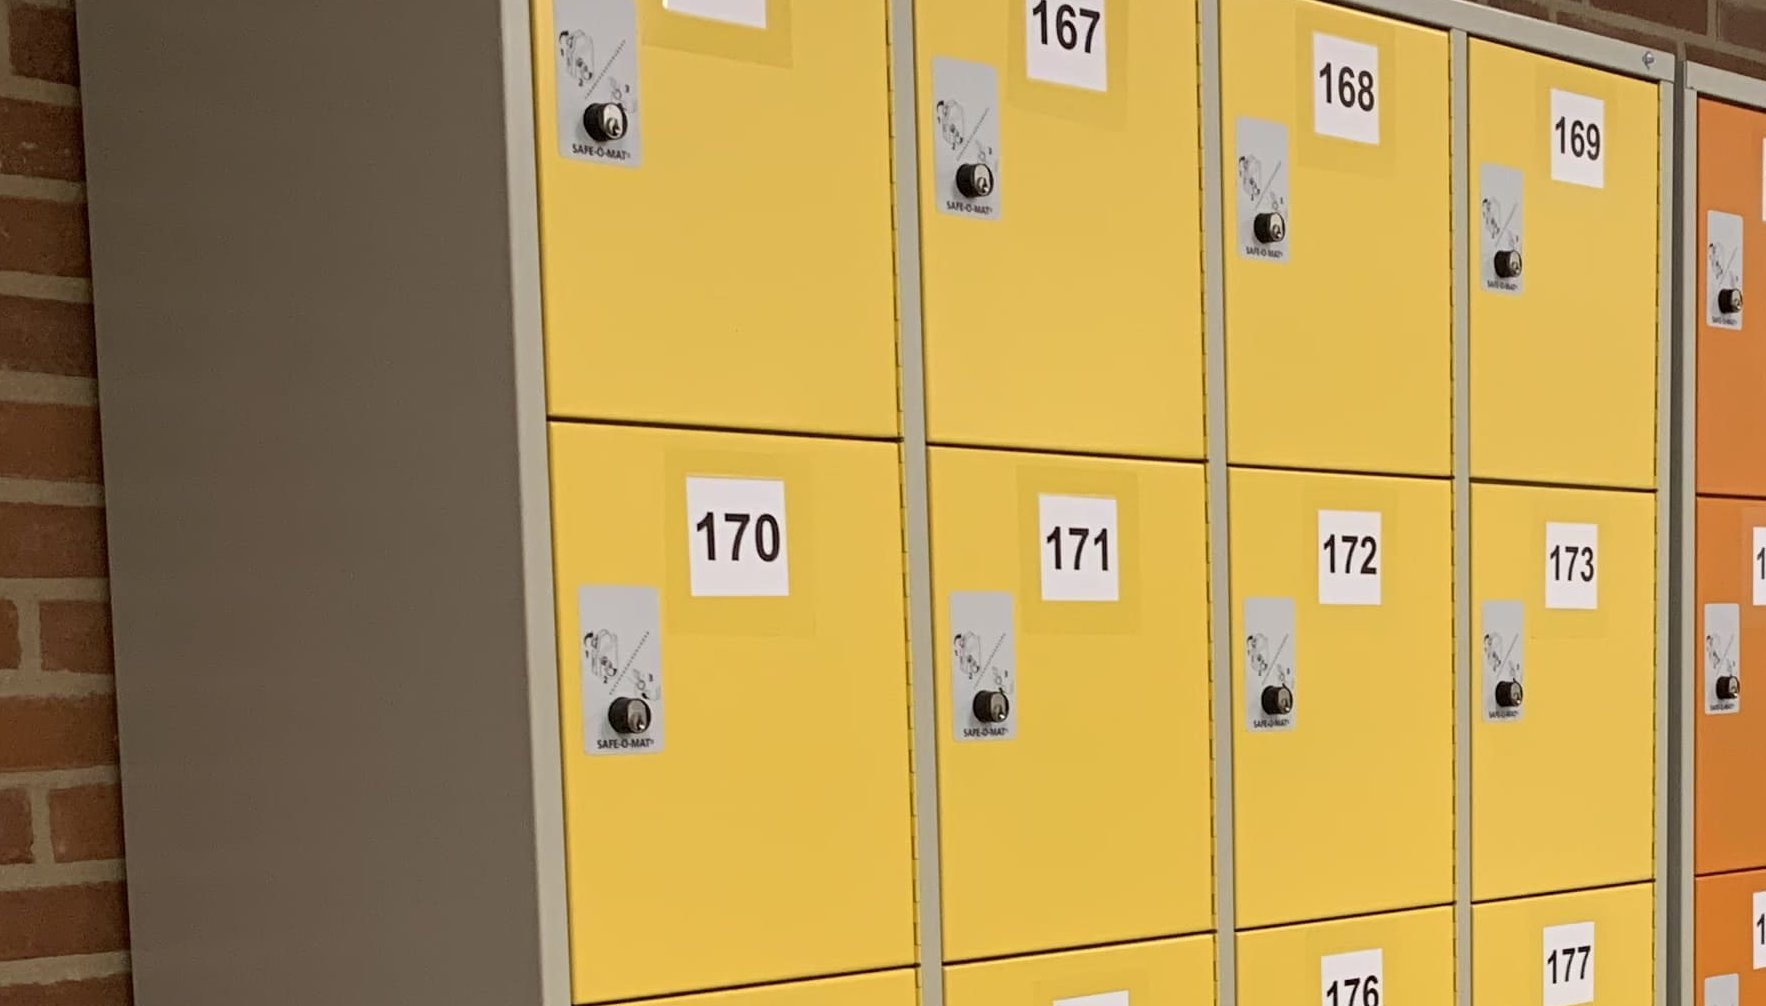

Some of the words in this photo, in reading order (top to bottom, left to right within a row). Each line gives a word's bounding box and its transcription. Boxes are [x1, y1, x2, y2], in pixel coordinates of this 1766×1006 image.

[1032, 0, 1101, 54] 167
[1319, 62, 1375, 112] 168
[1555, 116, 1601, 161] 169
[696, 511, 780, 563] 170
[1046, 526, 1109, 572] 171
[1323, 533, 1377, 575] 172
[1550, 544, 1594, 582] 173
[1547, 945, 1591, 985] 177
